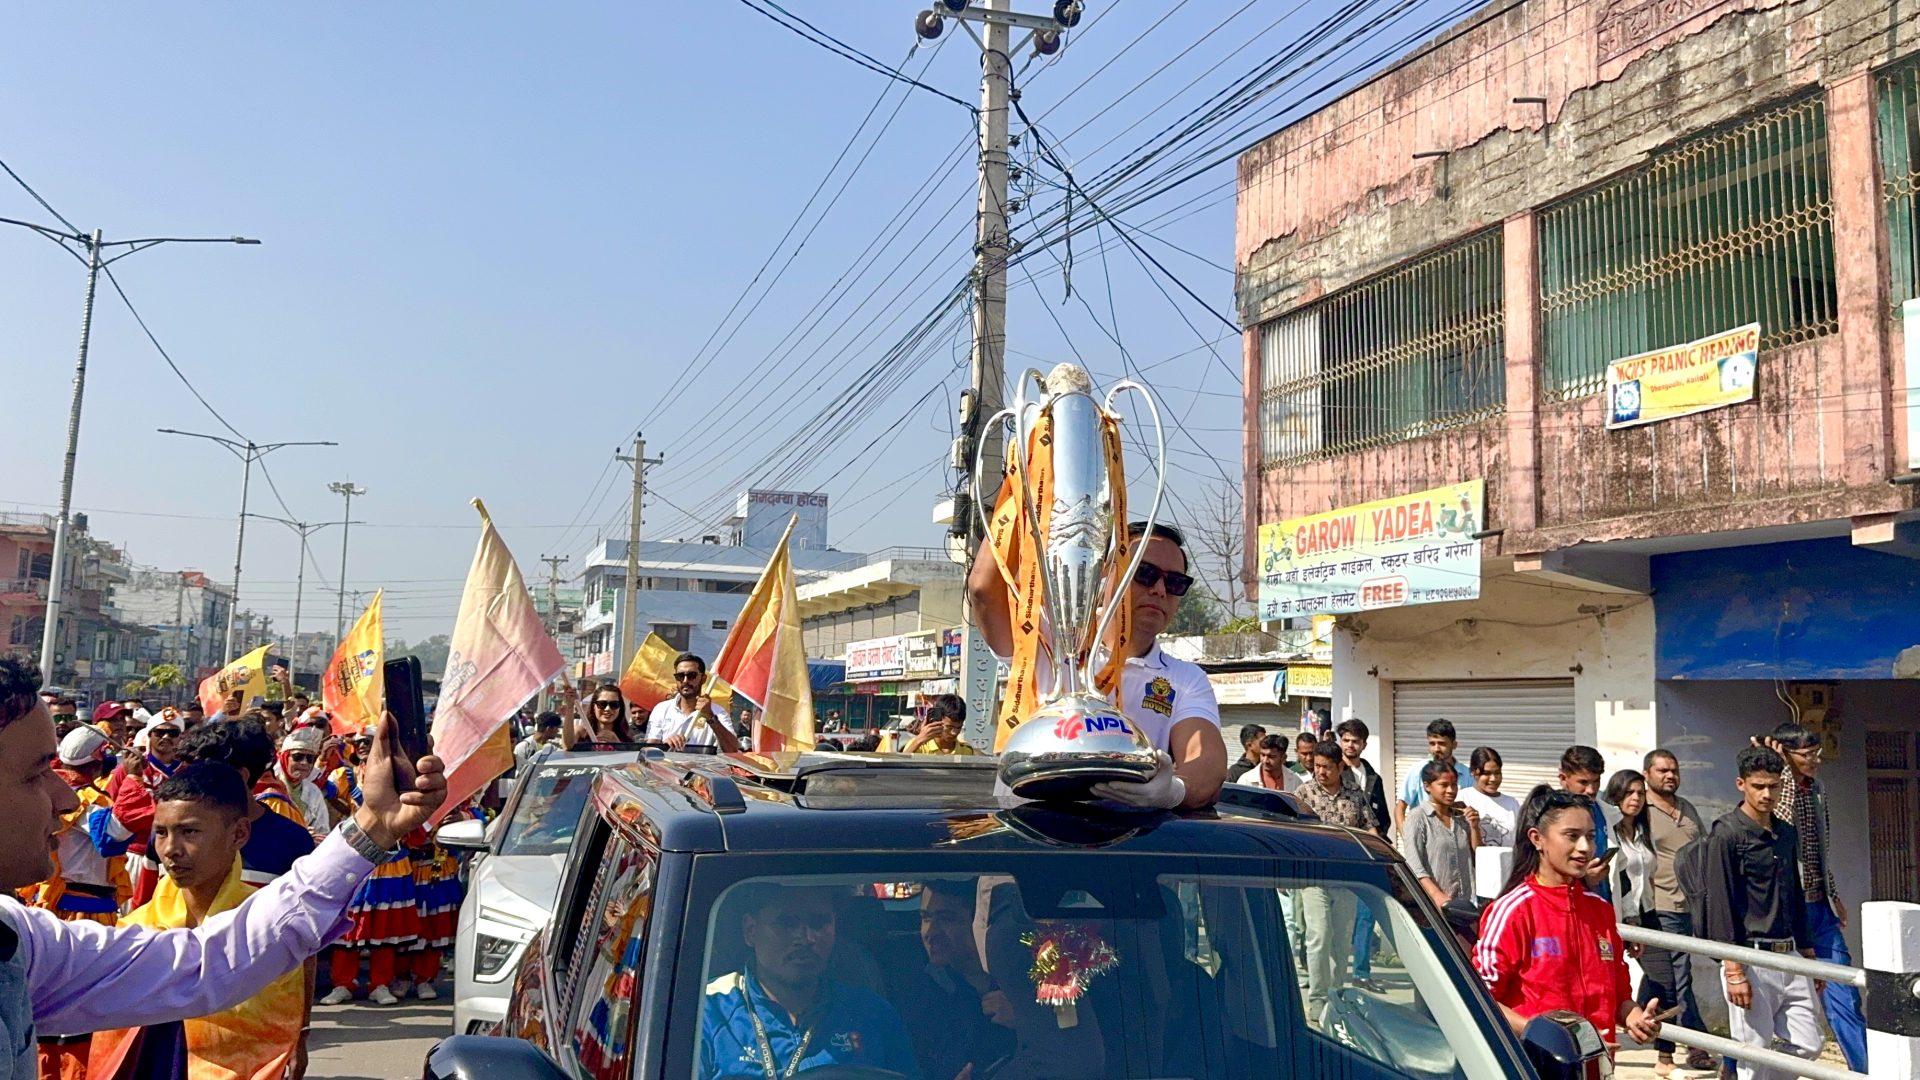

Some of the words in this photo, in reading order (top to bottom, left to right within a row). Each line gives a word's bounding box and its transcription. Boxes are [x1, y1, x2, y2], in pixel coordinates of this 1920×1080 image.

[1651, 348, 1697, 375] PRANIC
[1699, 330, 1756, 365] HEALING
[1296, 514, 1357, 556] GAROW
[1371, 500, 1433, 544] YADEA
[1413, 544, 1440, 565] खरिद
[1445, 541, 1474, 560] गरेमा
[1362, 580, 1403, 604] FREE
[1281, 597, 1292, 613] को
[1084, 716, 1134, 735] NPL
